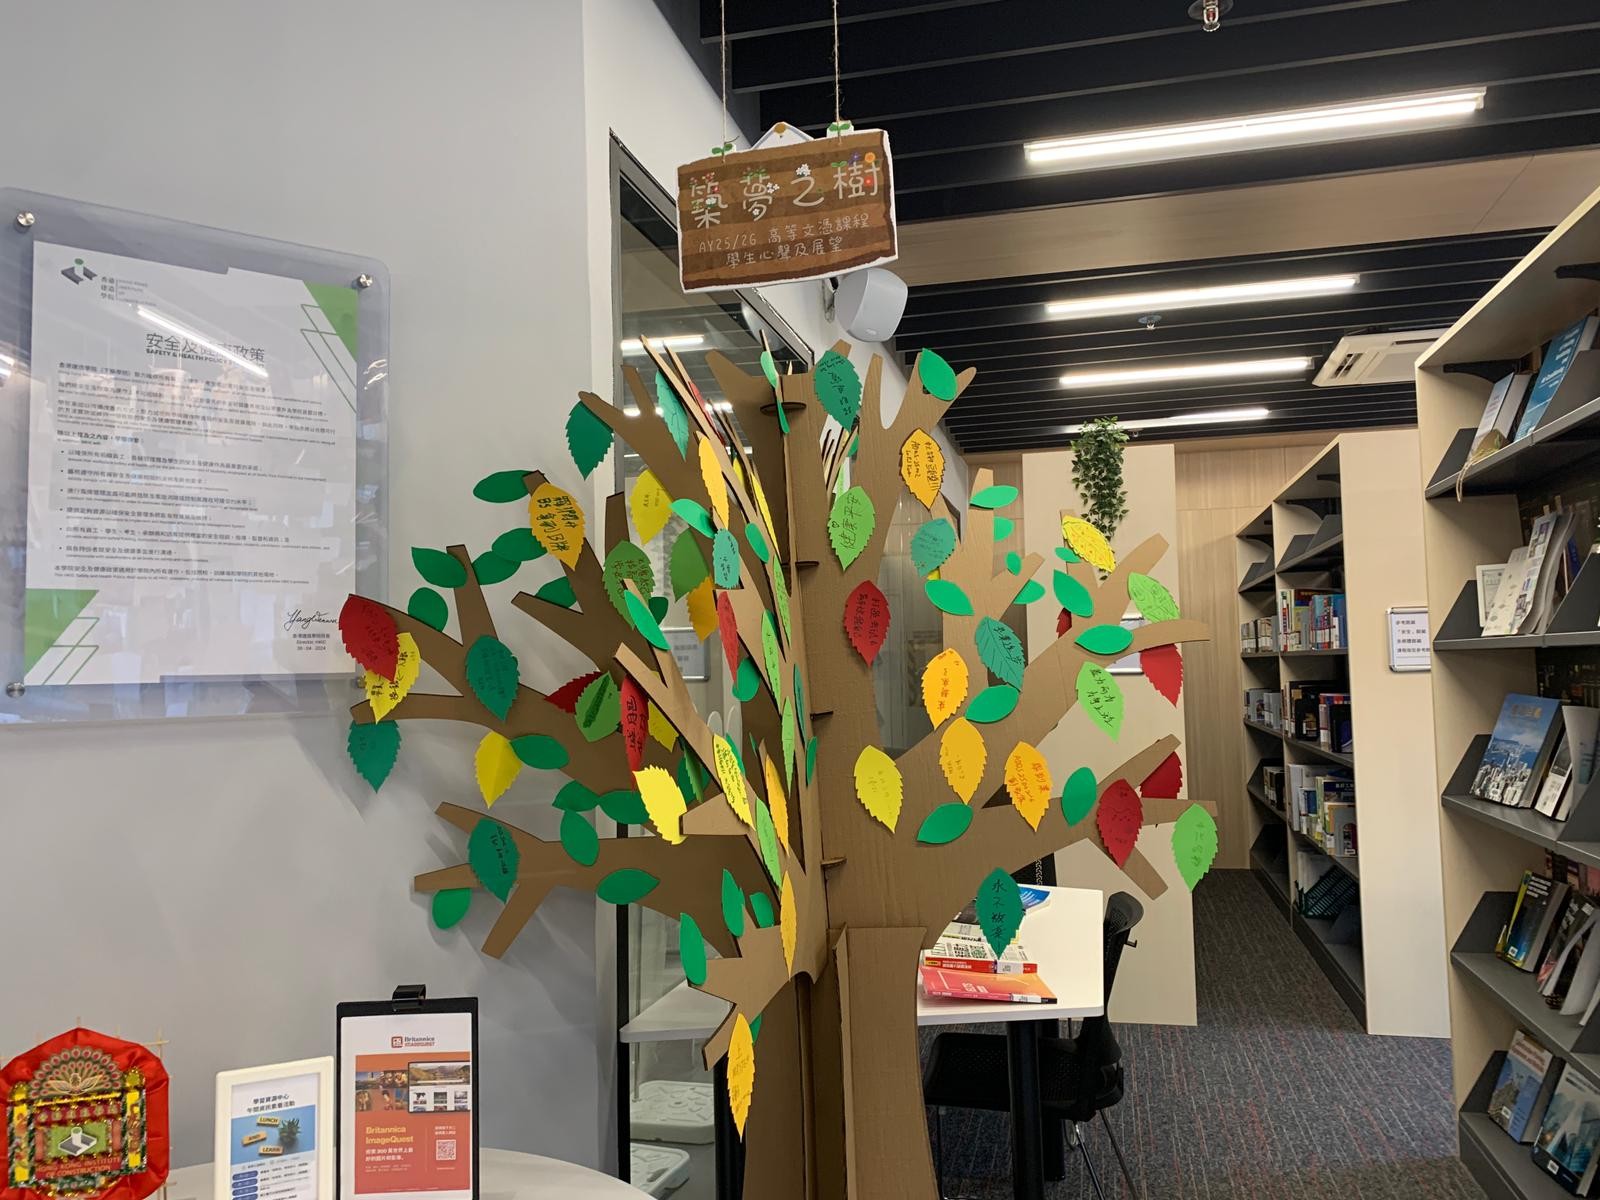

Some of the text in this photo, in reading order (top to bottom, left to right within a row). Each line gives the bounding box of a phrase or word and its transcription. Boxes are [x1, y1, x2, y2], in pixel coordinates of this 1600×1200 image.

[689, 160, 881, 229] 築夢之樹
[767, 212, 870, 243] 高等文憑課程
[725, 235, 843, 269] 學生心聲及展望
[366, 1126, 406, 1134] Britannica
[366, 1135, 414, 1145] ImageQuest
[57, 1165, 111, 1176] CONSTRUCTION
